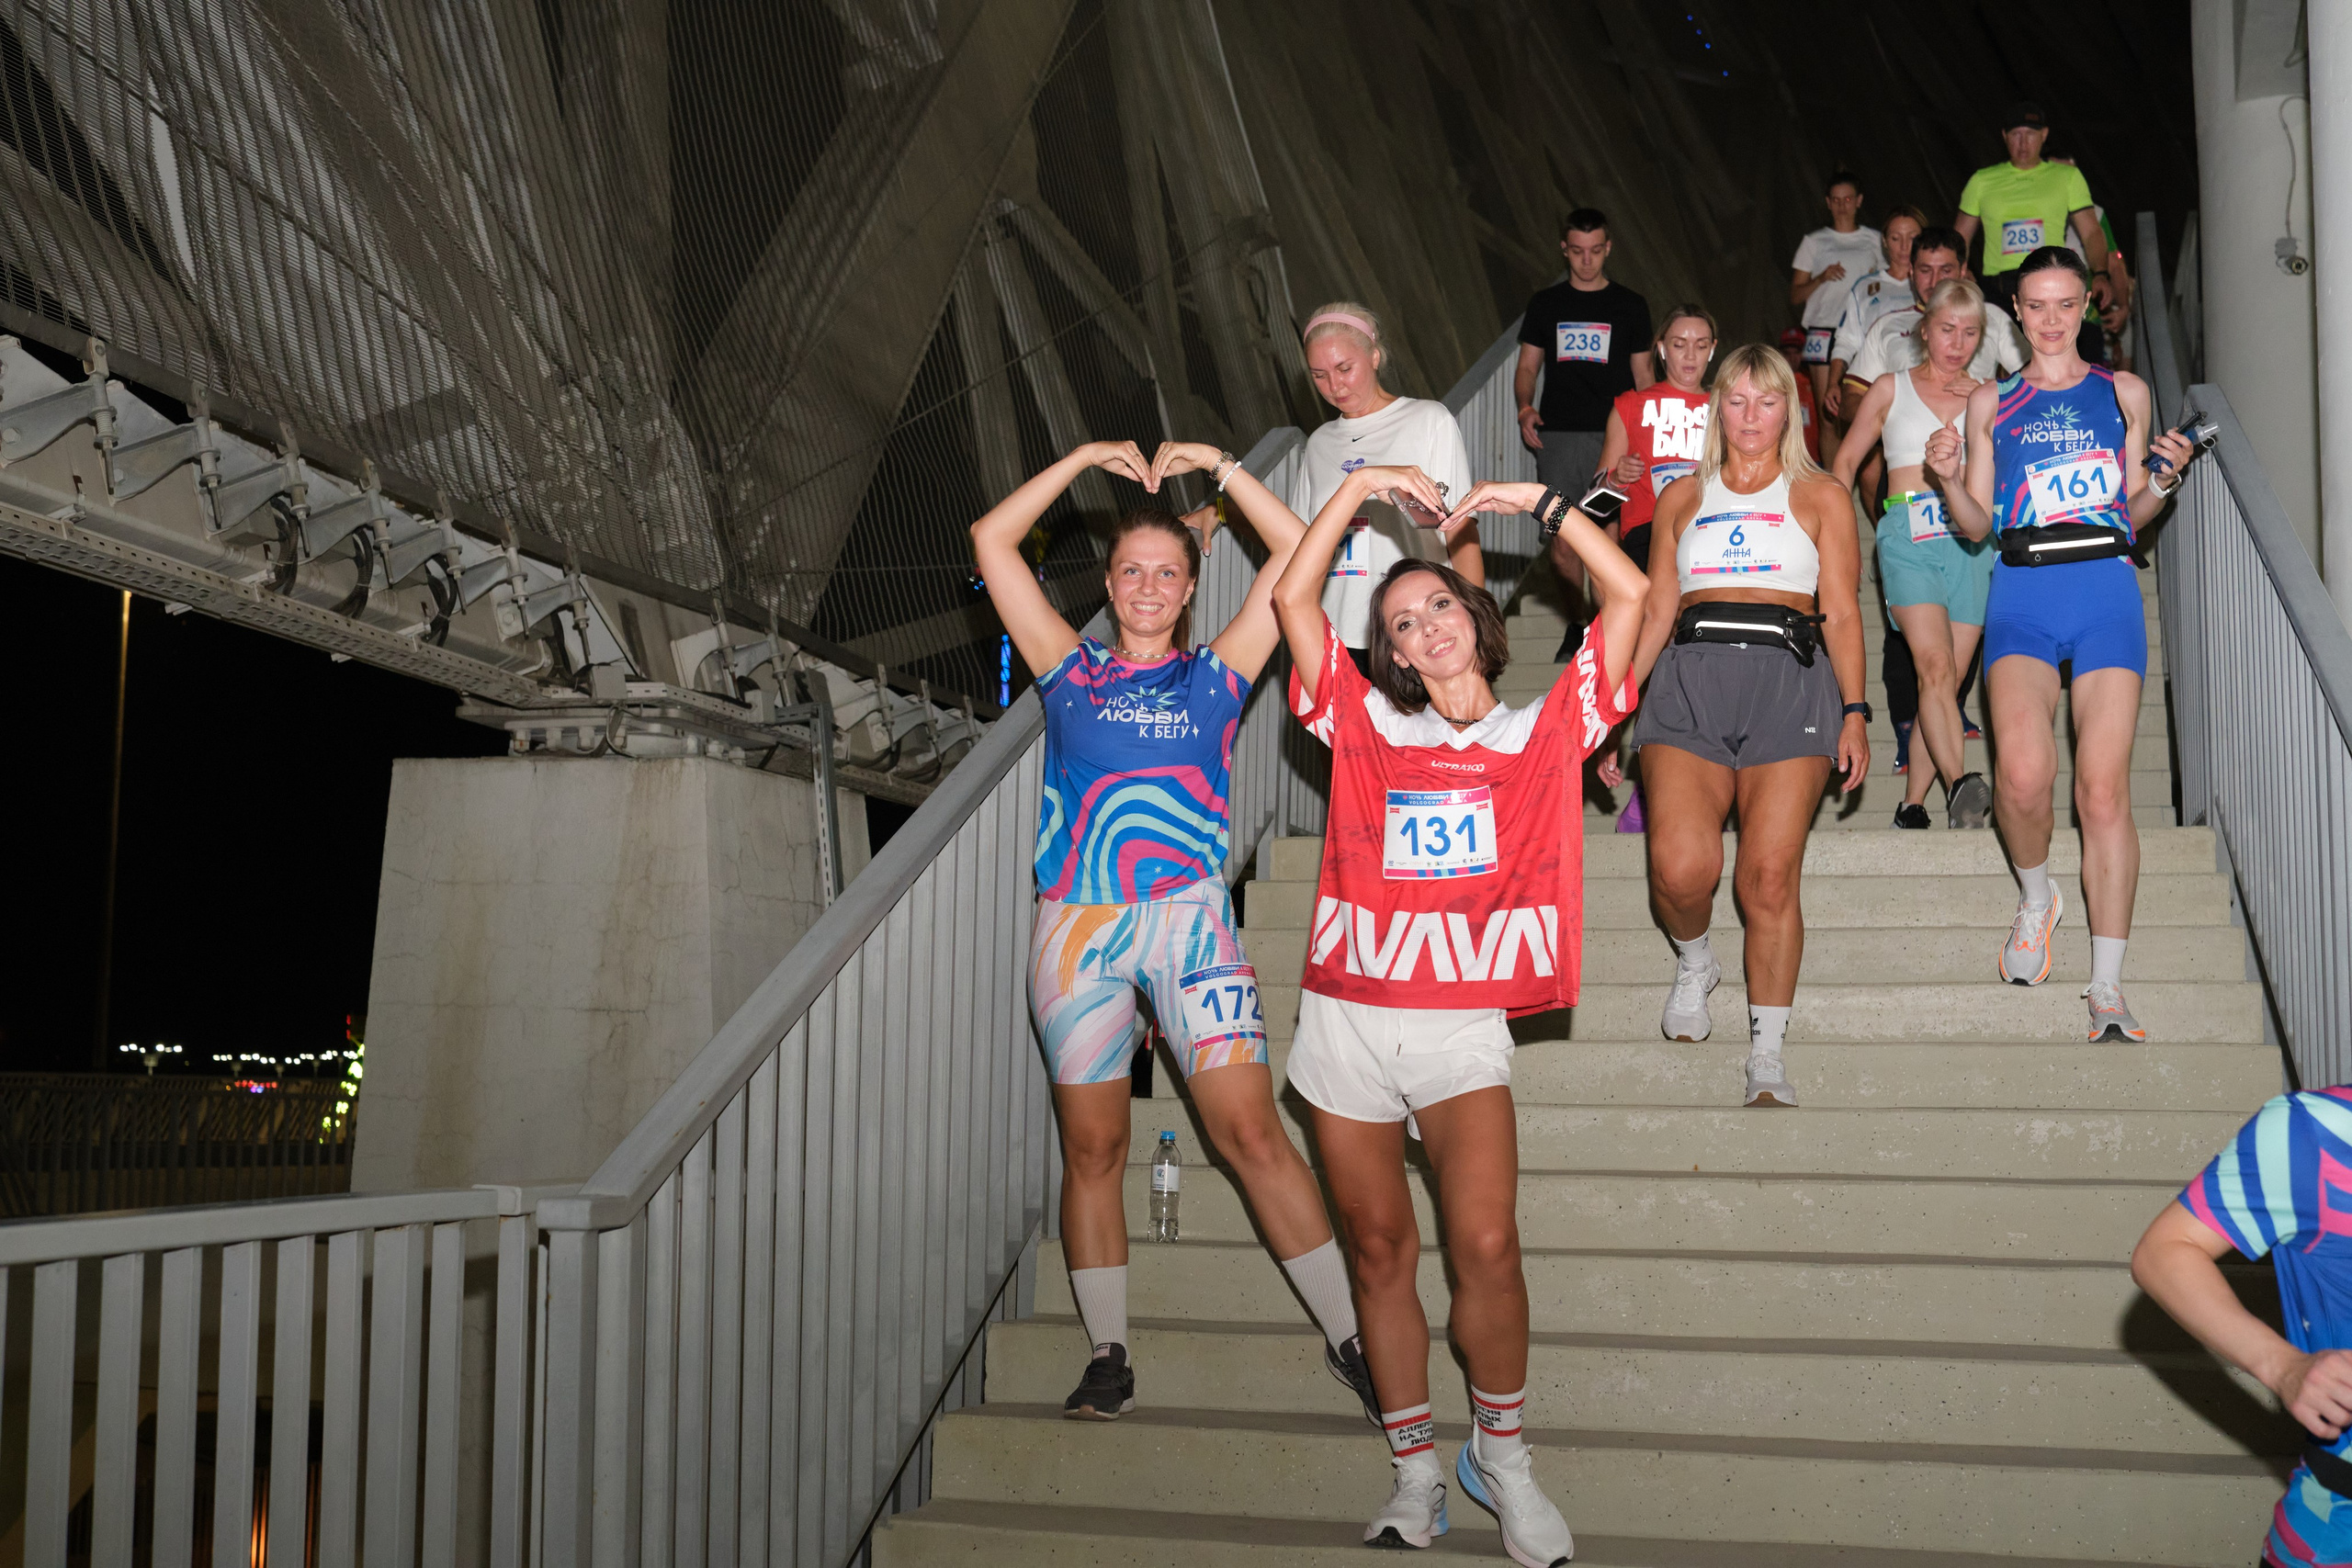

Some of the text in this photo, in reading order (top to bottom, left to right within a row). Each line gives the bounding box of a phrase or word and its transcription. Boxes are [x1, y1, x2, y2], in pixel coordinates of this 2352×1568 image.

[2007, 229, 2040, 246] 283
[1565, 333, 1600, 352] 238
[2024, 420, 2059, 433] НОЧЬ
[2020, 429, 2094, 445] ЛЮБВИ
[2053, 441, 2093, 452] К БЕГУ
[2047, 467, 2108, 502] 161
[1729, 525, 1745, 546] 6
[1722, 548, 1751, 558] АННА
[1106, 696, 1148, 712] НОЬ
[1097, 708, 1189, 725] ЛЮБВИ
[1139, 726, 1190, 739] К БЕГУ
[1431, 760, 1485, 772] ULTRA100
[1400, 814, 1476, 856] 131
[1201, 985, 1263, 1023] 172
[1399, 1433, 1416, 1441] НА
